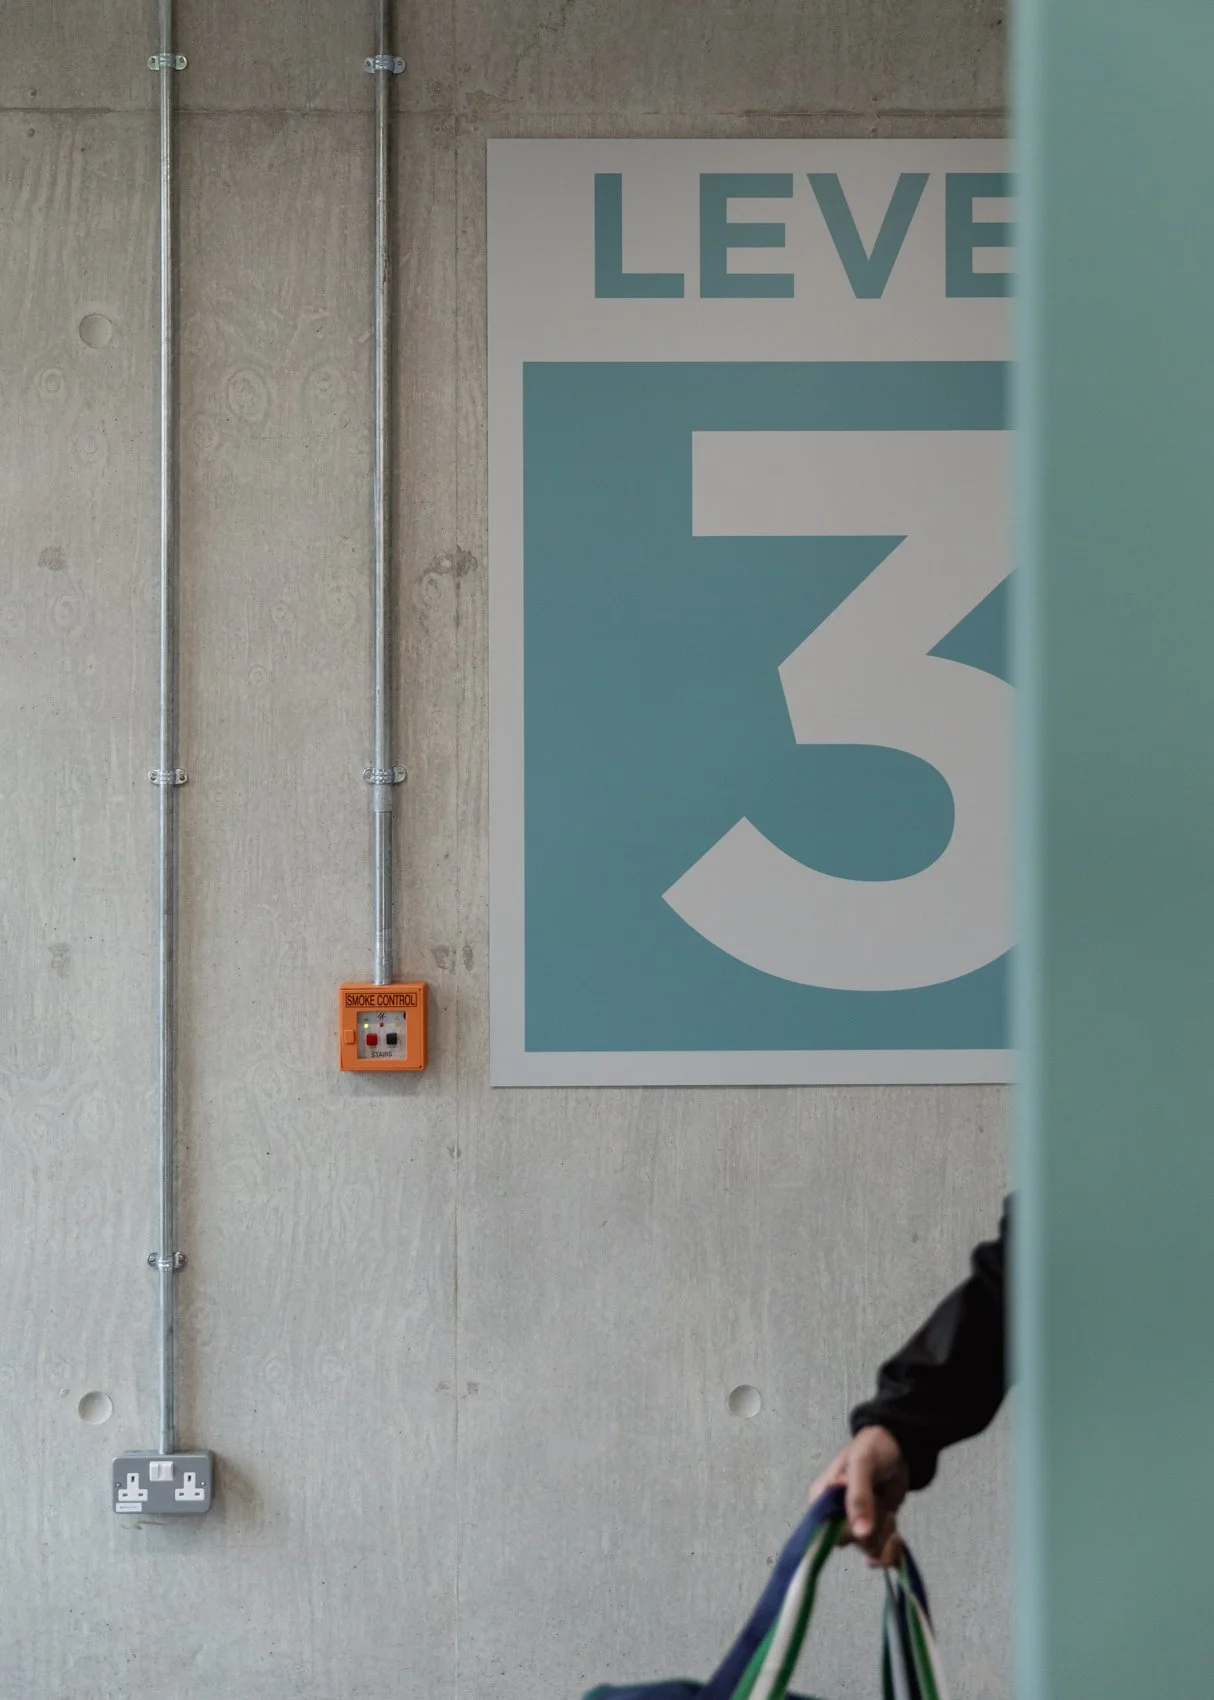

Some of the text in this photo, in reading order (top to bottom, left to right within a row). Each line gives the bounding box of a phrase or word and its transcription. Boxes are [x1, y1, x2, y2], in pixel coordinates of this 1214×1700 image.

[661, 430, 1019, 992] 3
[347, 994, 415, 1006] SMOKE CONTROL
